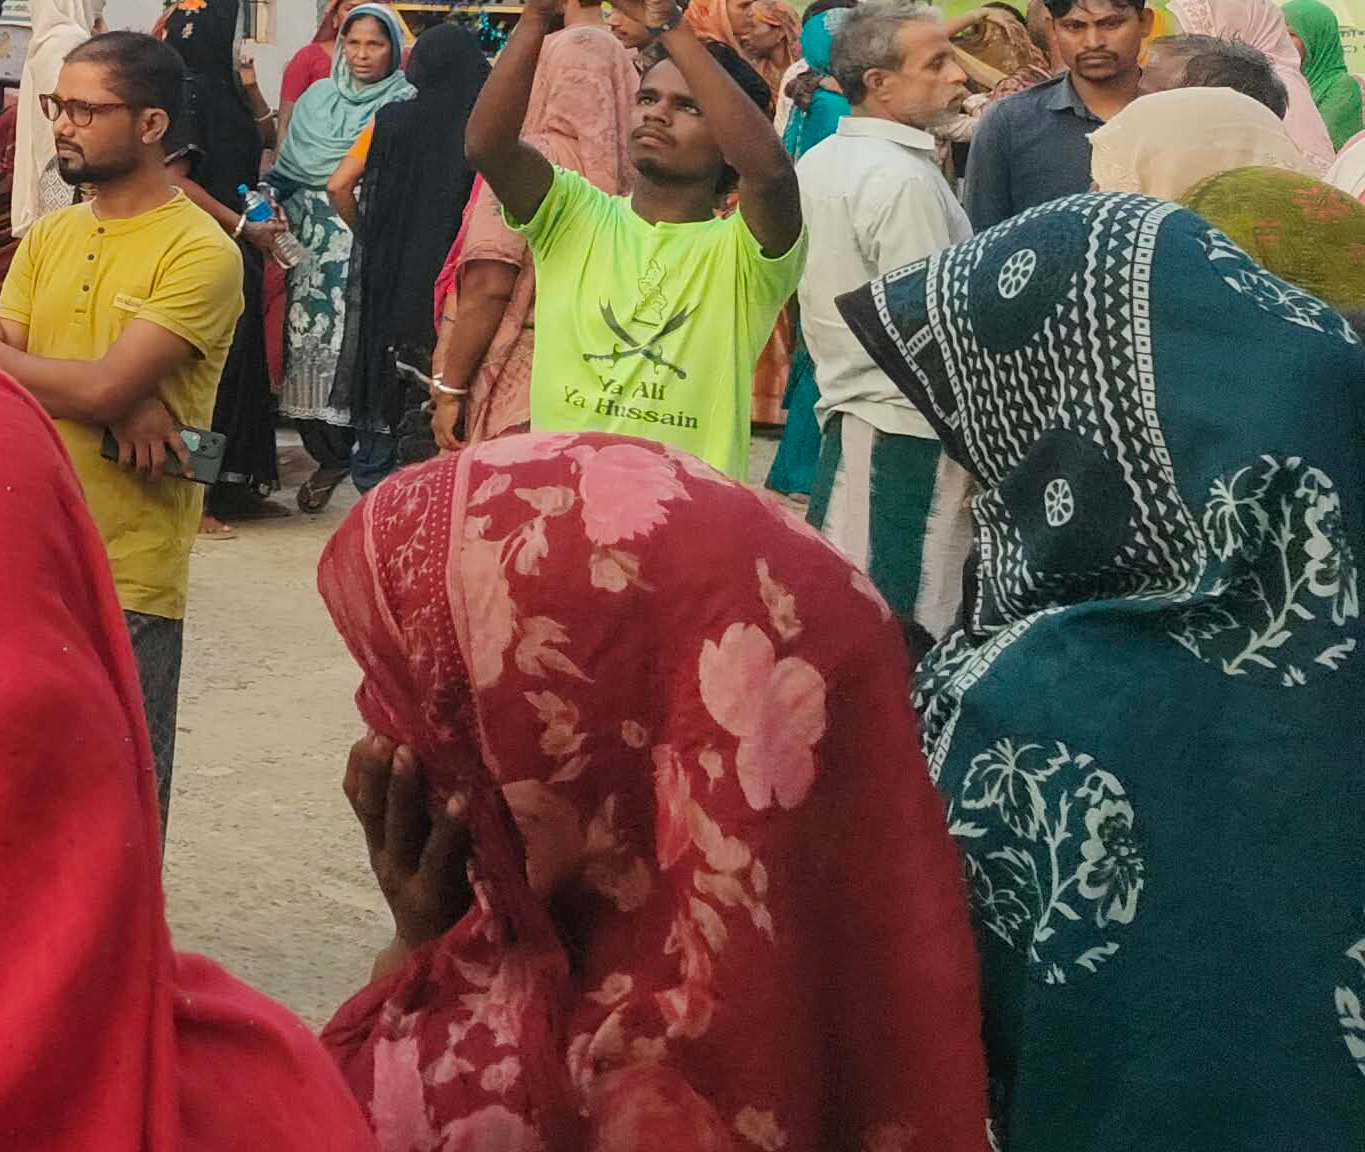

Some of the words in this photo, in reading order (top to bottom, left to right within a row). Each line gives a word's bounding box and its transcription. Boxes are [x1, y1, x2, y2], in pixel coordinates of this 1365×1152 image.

[598, 375, 624, 396] Ya
[632, 381, 666, 401] Ali
[564, 385, 586, 408] Ya
[594, 398, 699, 430] Hussain
